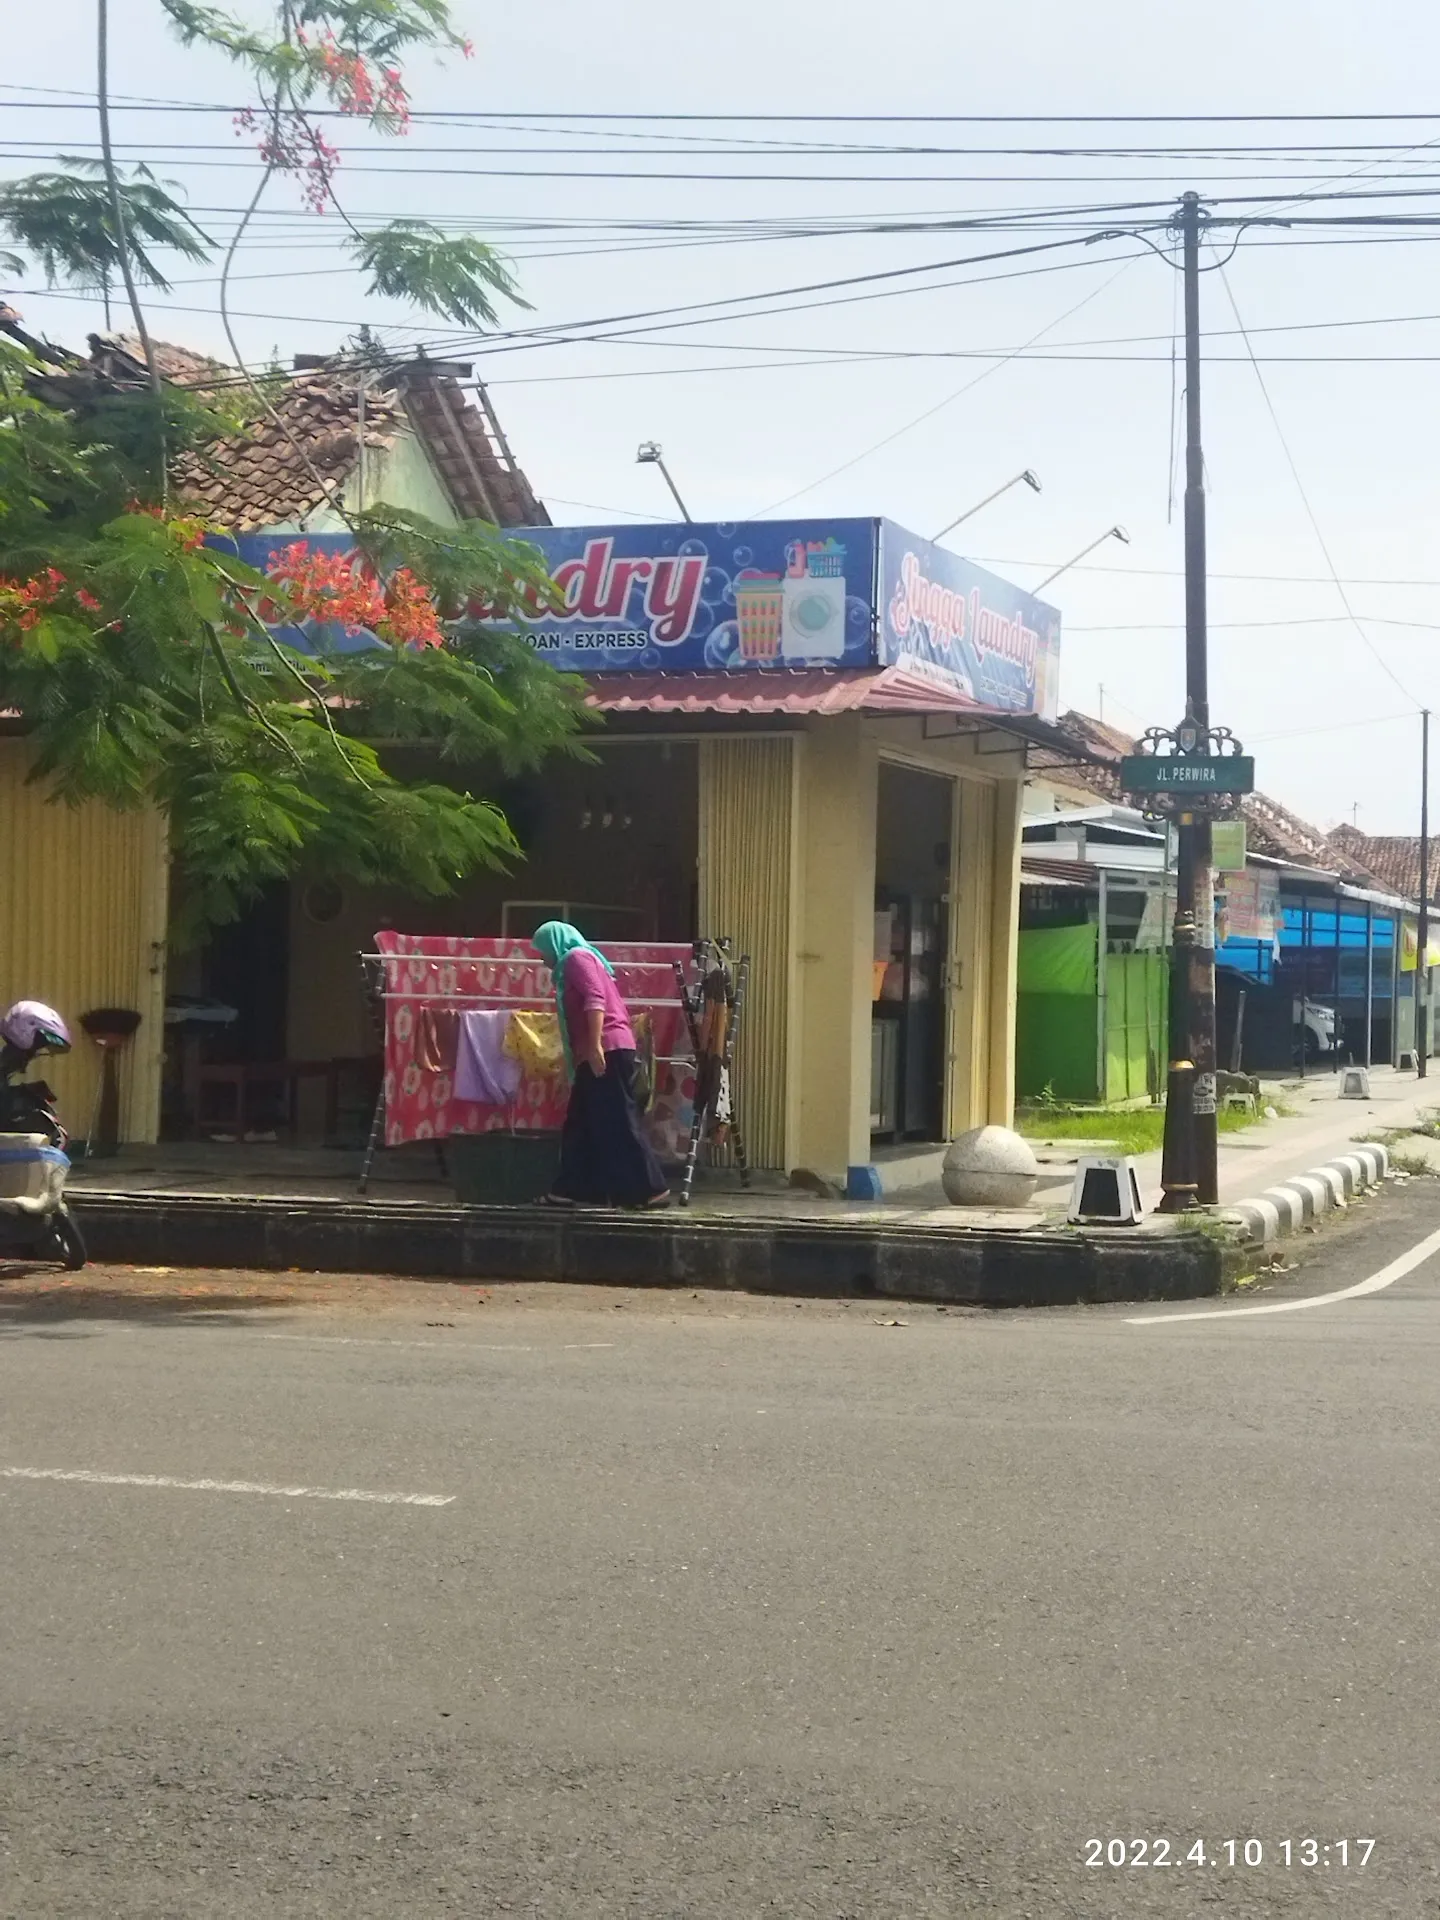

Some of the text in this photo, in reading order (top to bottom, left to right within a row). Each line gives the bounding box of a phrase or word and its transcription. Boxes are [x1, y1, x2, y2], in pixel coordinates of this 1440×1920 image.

[575, 630, 648, 650] EXPRESS
[968, 587, 1039, 688] Laundry
[1156, 767, 1217, 782] JL. PERWIRA
